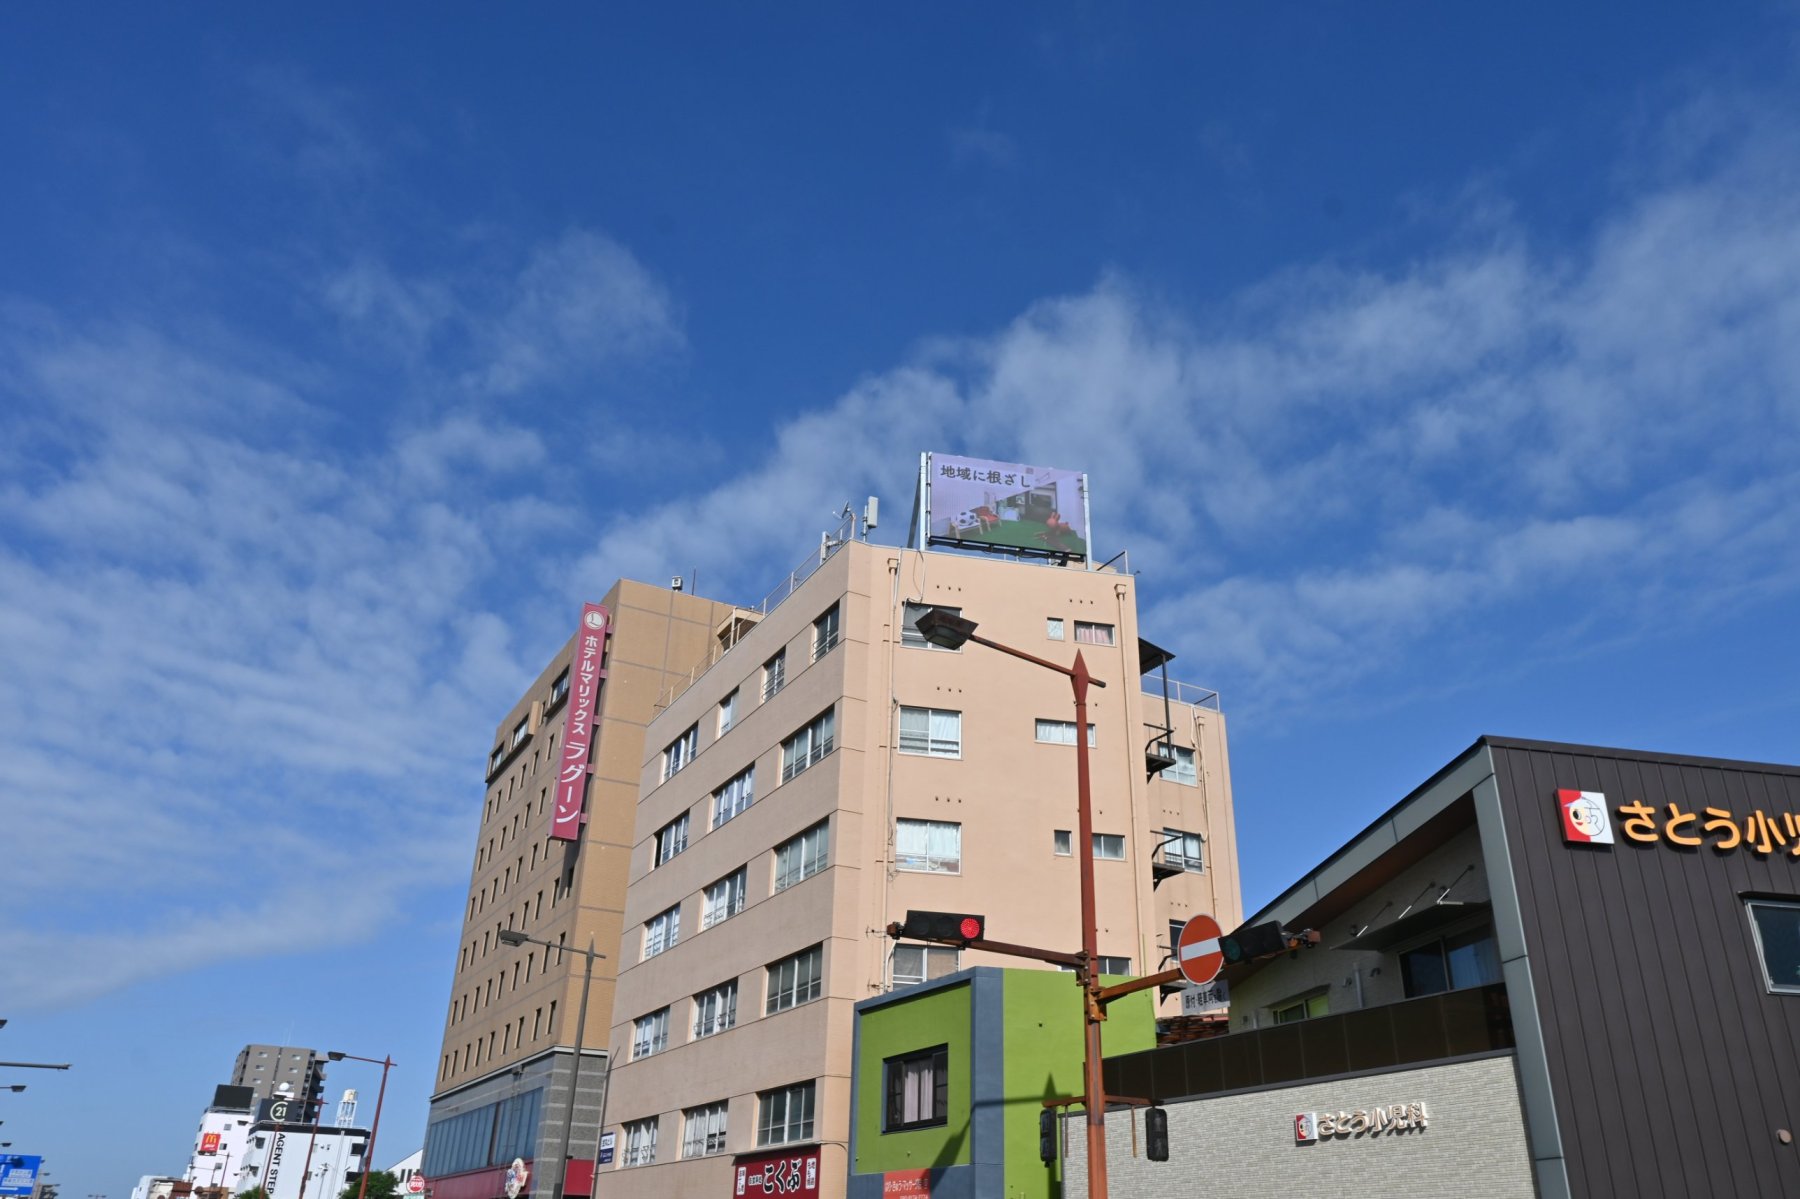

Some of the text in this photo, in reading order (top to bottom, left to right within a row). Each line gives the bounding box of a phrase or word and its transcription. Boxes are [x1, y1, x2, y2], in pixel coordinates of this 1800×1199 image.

[940, 465, 1031, 488] 地域に根ざし
[1319, 1102, 1428, 1135] さとう小児科
[267, 1133, 286, 1194] AGENT STEP
[763, 1158, 802, 1194] こくぶ
